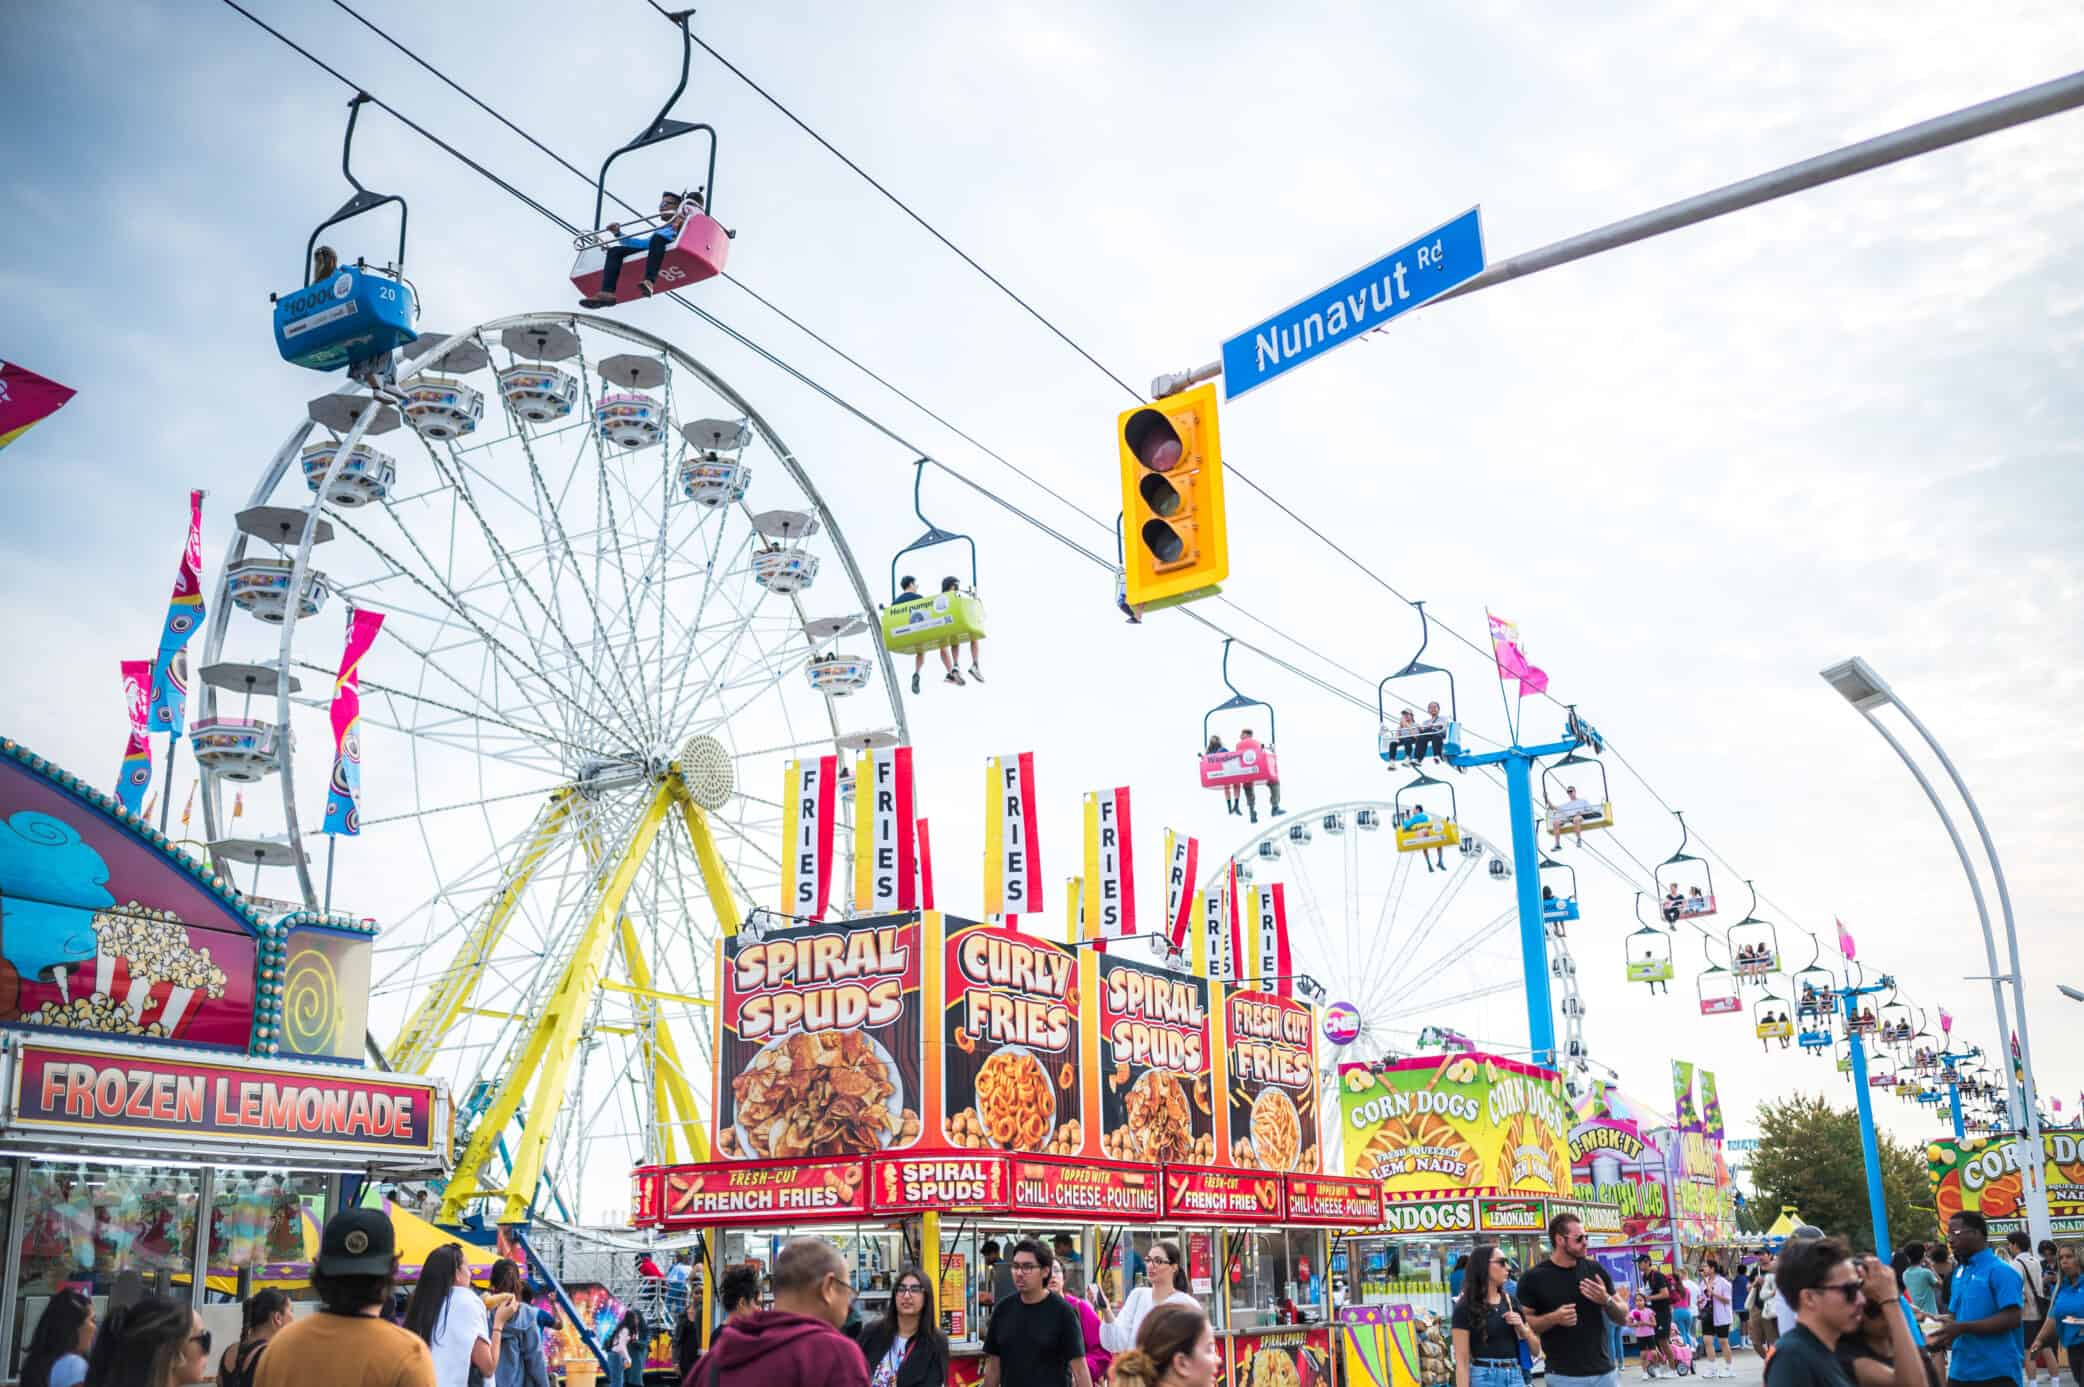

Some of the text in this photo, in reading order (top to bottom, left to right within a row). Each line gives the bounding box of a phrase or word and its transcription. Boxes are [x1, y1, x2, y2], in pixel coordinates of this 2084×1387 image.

[379, 286, 396, 301] 20
[1255, 239, 1443, 372] Nunavut Rd
[799, 771, 816, 902] FRIES
[878, 762, 893, 898] FRIES
[1005, 768, 1022, 901] FRIES
[1101, 801, 1118, 926] FRIES
[1169, 843, 1186, 930] FRI
[735, 928, 908, 992] SPIRAL
[960, 933, 1073, 999] CURLY
[1207, 899, 1220, 976] FRIE
[1261, 893, 1274, 992] FRIES
[738, 980, 903, 1040] SPUDS
[965, 989, 1070, 1052] FRIES
[1109, 968, 1202, 1028] SPIRAL
[1233, 1000, 1309, 1045] FRESH CUT
[1112, 1021, 1201, 1072] SPUDS
[1235, 1041, 1312, 1087] FRIES
[41, 1061, 413, 1138] FROZEN LEMONADE
[1351, 1090, 1479, 1128] CORN DOGS
[1488, 1078, 1562, 1137] CORN DOGS
[692, 1186, 838, 1211] FRENCH FRIES
[729, 1167, 797, 1186] FRESH-CUT
[903, 1164, 986, 1182] SPIRAL
[905, 1181, 985, 1201] SPUDS
[1060, 1167, 1111, 1184] TOPPED WITH
[1185, 1192, 1257, 1211] FRENCH FRIES
[1358, 1203, 1472, 1231] NDOGS
[1490, 1212, 1536, 1226] LEMONADE
